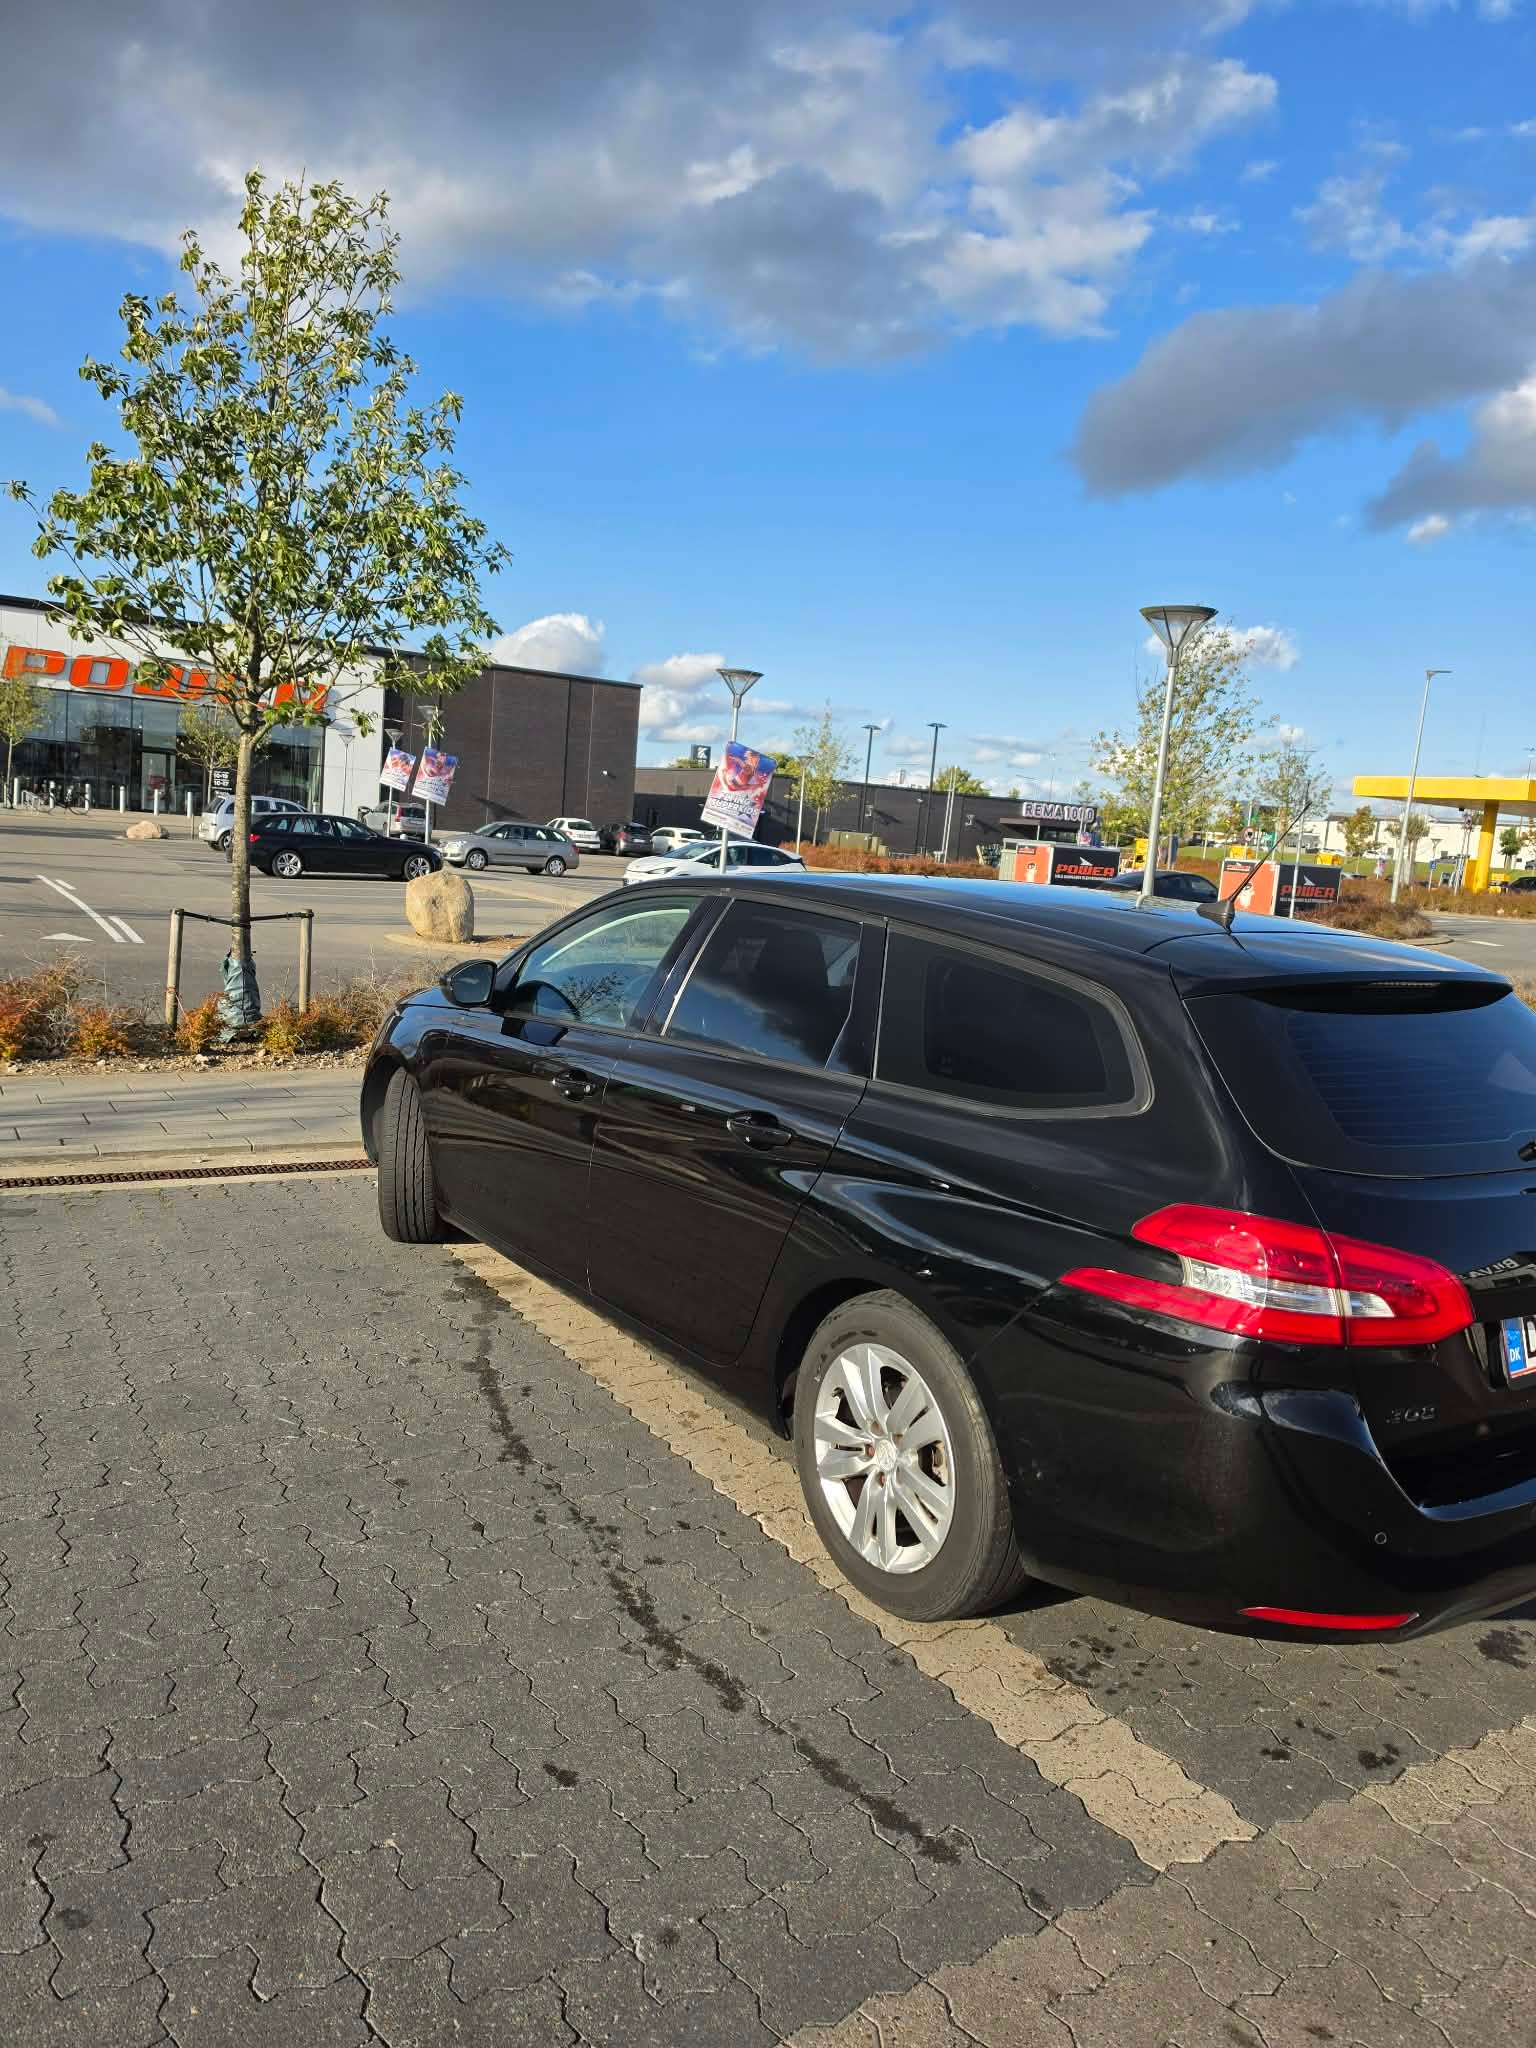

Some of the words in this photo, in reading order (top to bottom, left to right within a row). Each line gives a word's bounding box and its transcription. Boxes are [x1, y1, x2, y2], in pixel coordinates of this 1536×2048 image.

[1022, 801, 1063, 819] REMA
[1056, 863, 1115, 877] POWER
[1509, 1347, 1522, 1362] DK
